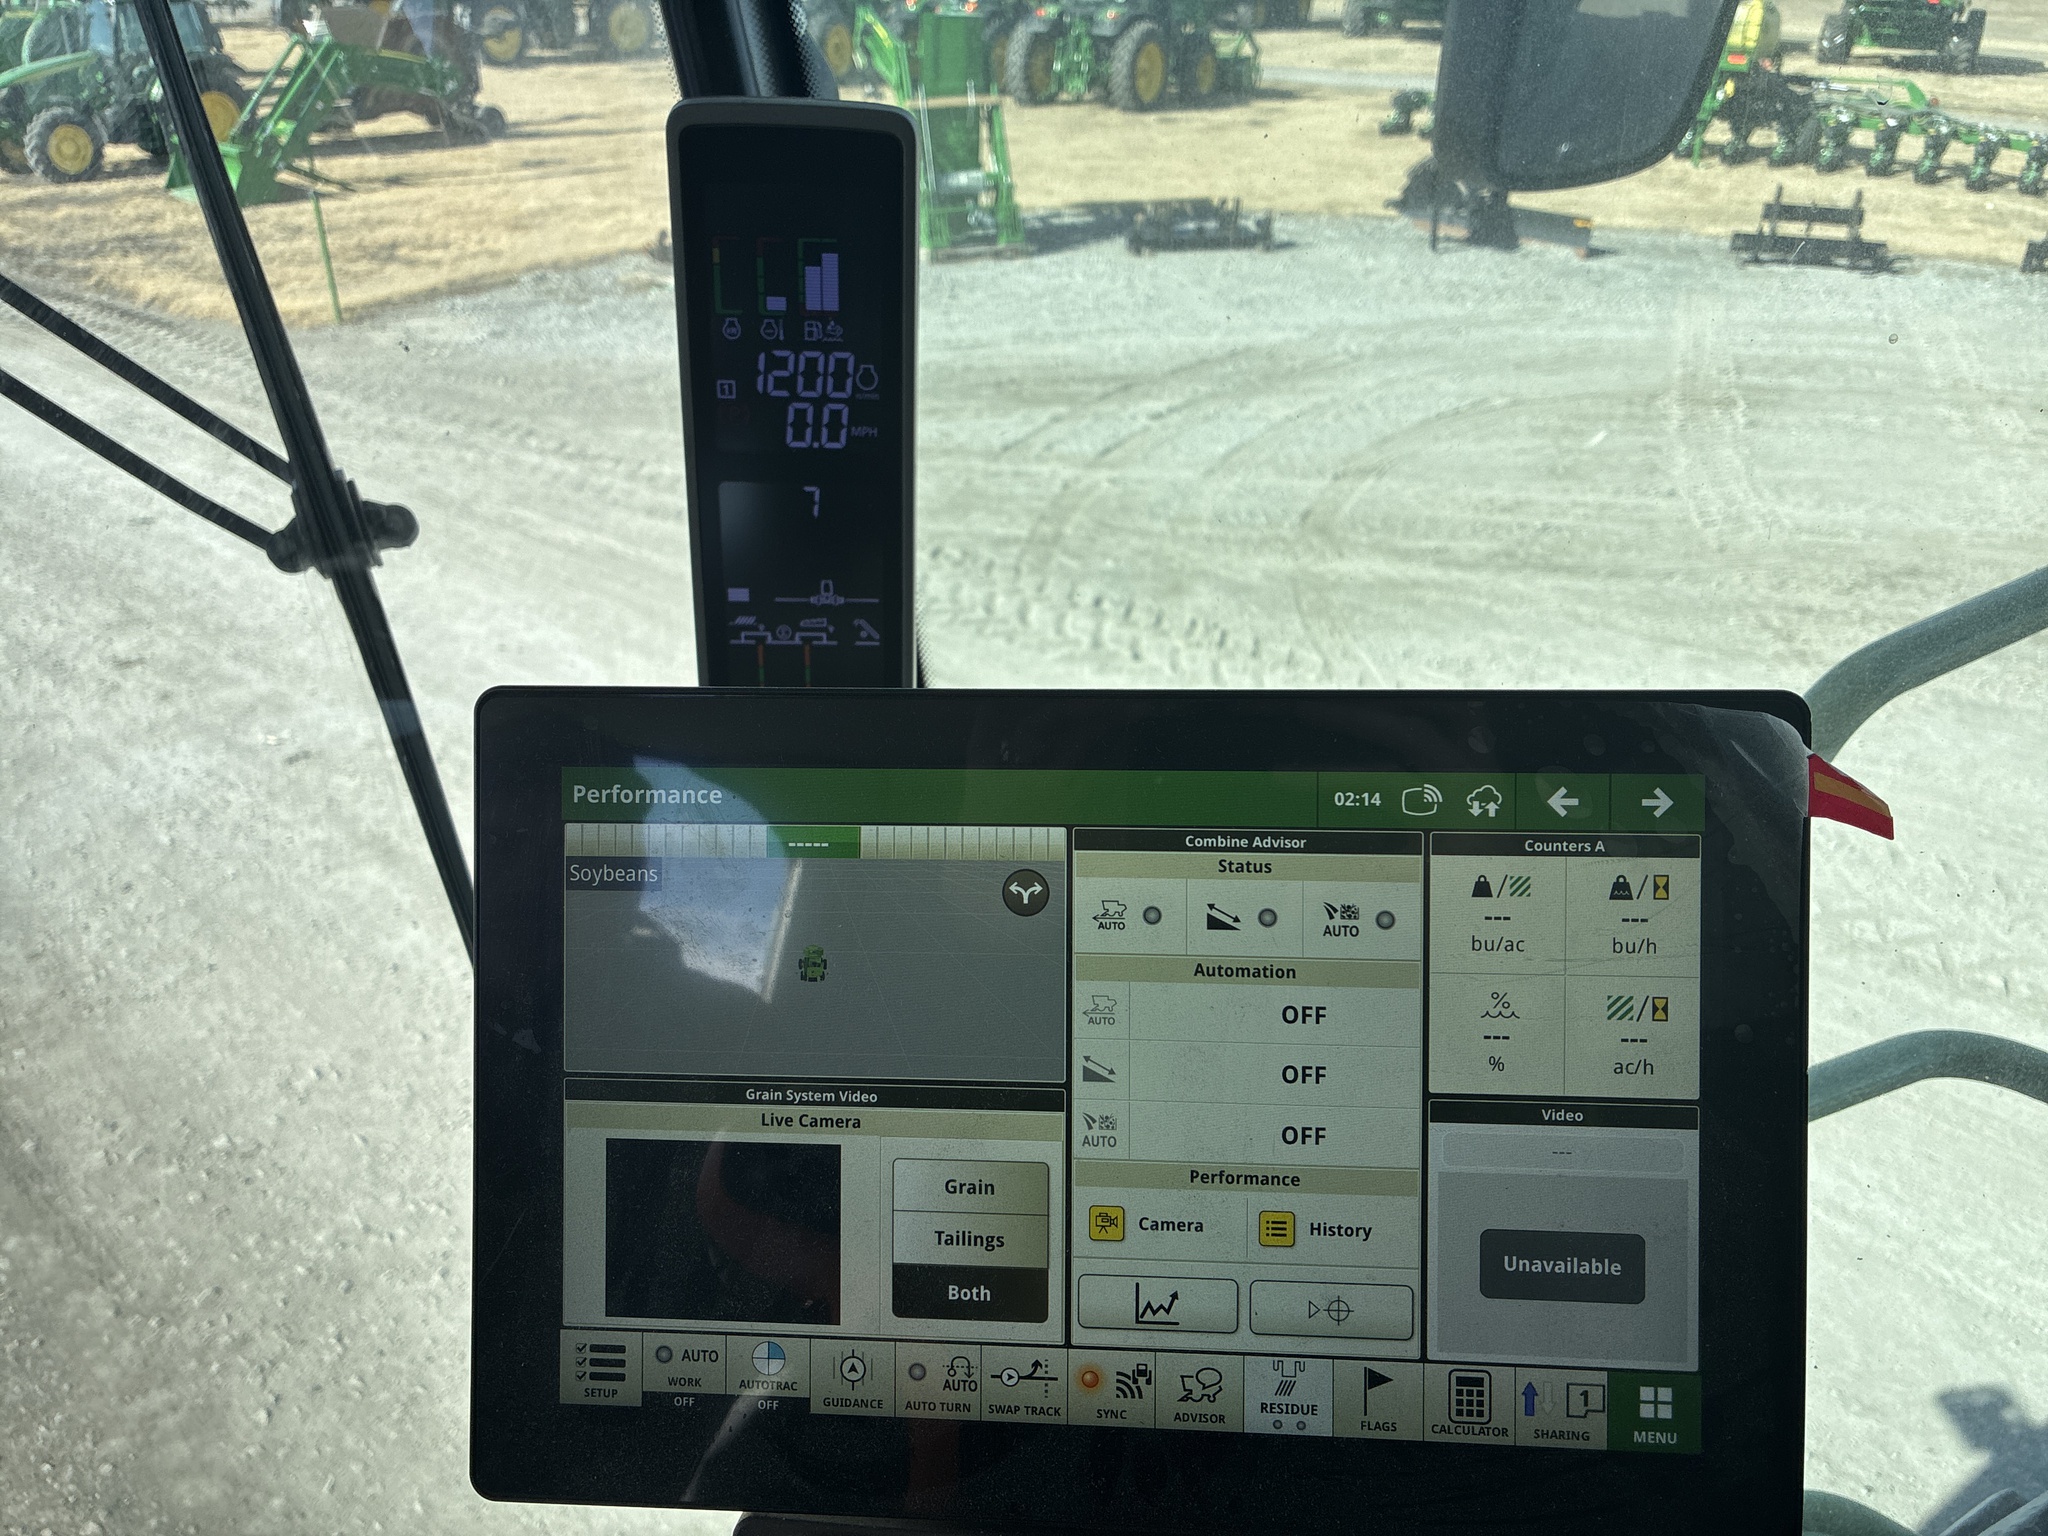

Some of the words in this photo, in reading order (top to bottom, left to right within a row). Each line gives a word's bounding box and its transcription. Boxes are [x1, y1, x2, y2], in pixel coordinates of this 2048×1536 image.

[756, 350, 855, 398] 1200
[786, 402, 849, 449] 0.0
[851, 427, 877, 437] MPH
[803, 486, 819, 519] 7
[572, 784, 723, 804] Performance
[1334, 792, 1381, 807] 02:14
[1185, 835, 1248, 848] Combine
[1252, 835, 1307, 850] Advisor
[1524, 839, 1592, 853] Counters
[1594, 840, 1605, 853] A
[1218, 858, 1273, 874] Status
[569, 864, 658, 885] Soybeans
[1097, 921, 1126, 931] AUTO
[1323, 925, 1360, 937] AUTO
[1471, 935, 1525, 953] bu/ac
[1612, 938, 1657, 955] bu/h
[1193, 963, 1297, 980] Automation
[1087, 1015, 1115, 1026] AUTO
[1281, 1006, 1327, 1025] OFF
[1488, 1057, 1505, 1073] %
[1613, 1059, 1655, 1076] ac/h
[1281, 1066, 1327, 1084] OFF
[746, 1088, 783, 1101] Grain
[786, 1089, 836, 1104] System
[838, 1091, 878, 1103] Video
[760, 1113, 795, 1127] Live
[798, 1113, 862, 1129] Camera
[1541, 1108, 1584, 1122] Video
[1081, 1135, 1117, 1148] AUTO
[1281, 1126, 1327, 1145] OFF
[1189, 1170, 1301, 1187] Performance
[944, 1178, 995, 1195] Grain
[1138, 1216, 1205, 1232] Camera
[1309, 1221, 1373, 1241] History
[934, 1230, 1006, 1250] Tailings
[1503, 1255, 1622, 1275] Unavailable
[947, 1285, 992, 1302] Both
[681, 1349, 719, 1363] AUTO
[667, 1377, 702, 1388] WORK
[739, 1380, 798, 1391] AUTOTRAC
[942, 1378, 978, 1393] AUTO
[584, 1388, 618, 1399] SETUP
[1579, 1389, 1591, 1407] 1
[673, 1396, 695, 1407] OFF
[757, 1399, 779, 1411] OFF
[823, 1398, 884, 1409] GUIDANCE
[905, 1401, 937, 1412] AUTO
[939, 1402, 972, 1413] TURN
[988, 1404, 1021, 1416] SWAP
[1024, 1405, 1062, 1417] TRACK
[1095, 1408, 1128, 1421] SYNC
[1260, 1402, 1319, 1417] RESIDUE
[1173, 1412, 1226, 1424] ADVISOR
[1360, 1419, 1398, 1433] FLAGS
[1431, 1424, 1509, 1438] CALCULATOR
[1533, 1428, 1590, 1442] SHARING
[1633, 1430, 1678, 1444] MENU
